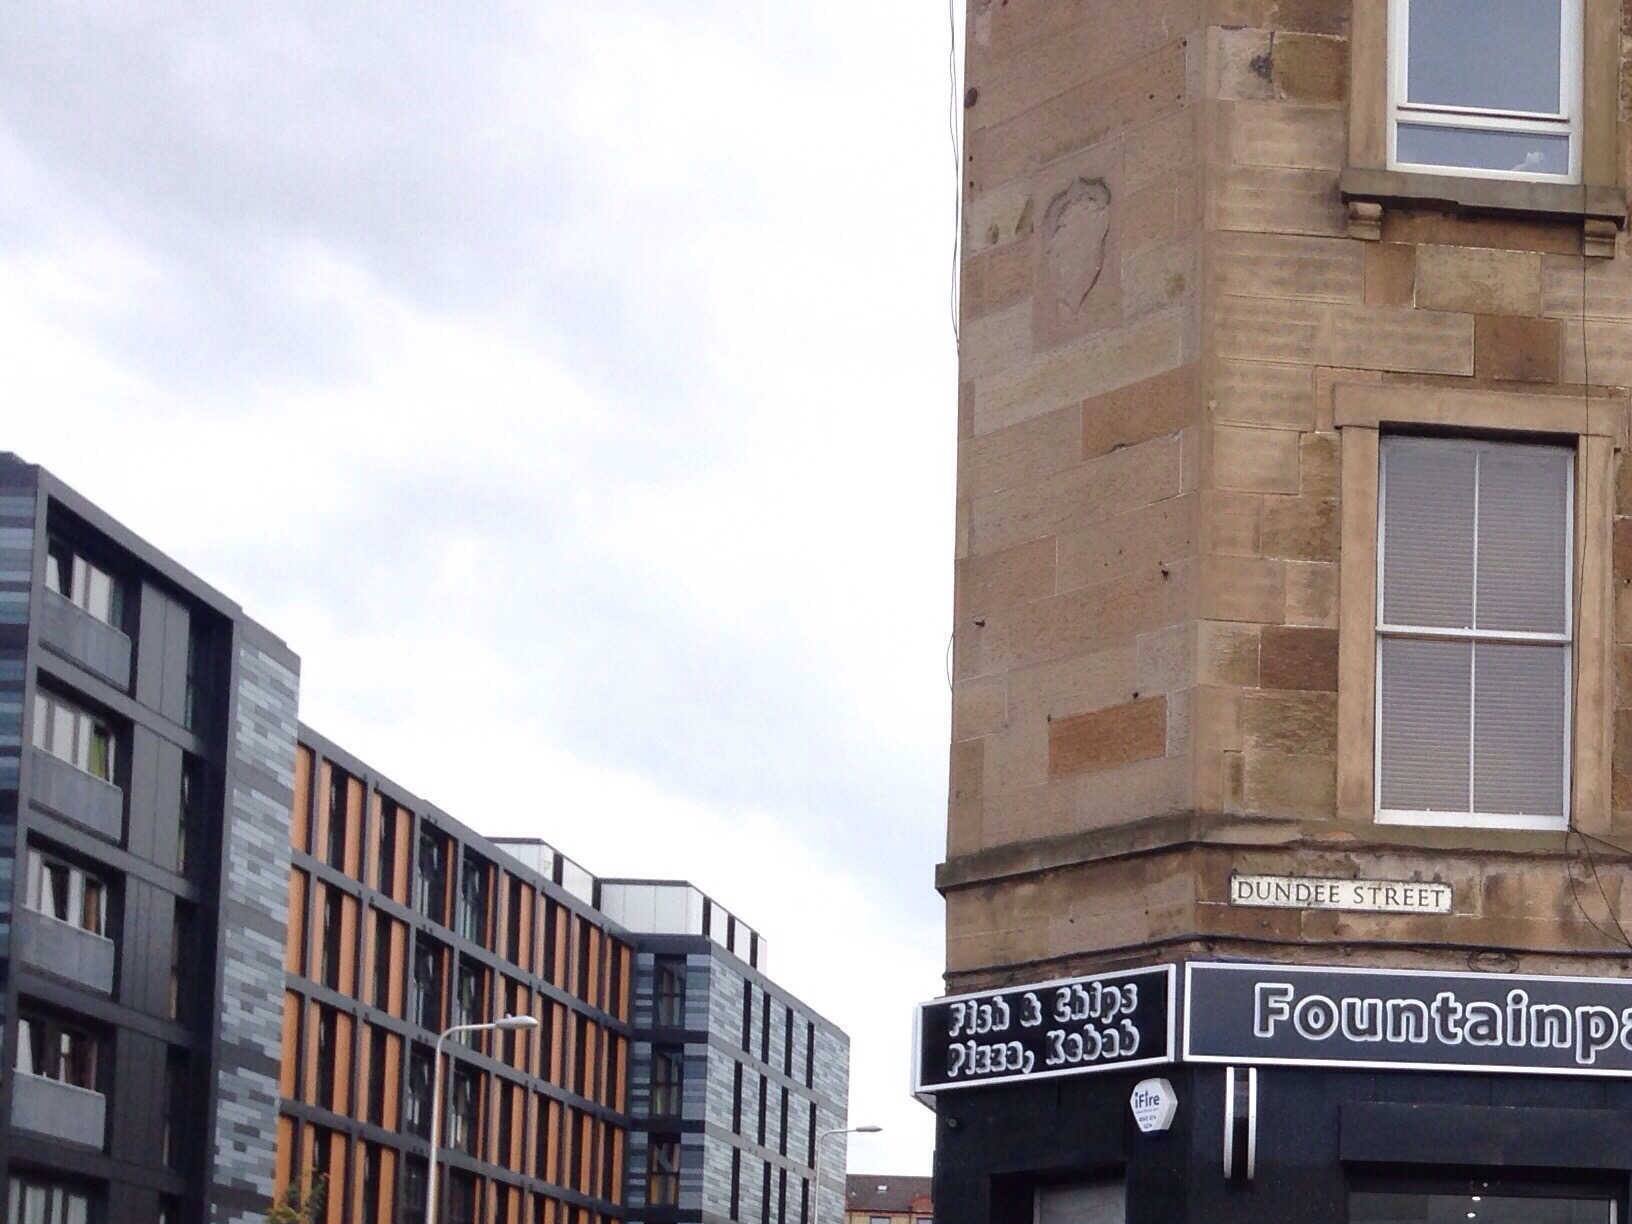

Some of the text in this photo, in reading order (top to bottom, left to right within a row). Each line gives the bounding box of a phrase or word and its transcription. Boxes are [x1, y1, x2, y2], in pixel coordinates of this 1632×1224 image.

[1238, 880, 1445, 908] DUNDEE STREET
[949, 981, 1138, 1037] Fish & Chips
[947, 1018, 1139, 1077] Pizza, Kebab
[1135, 1091, 1160, 1108] iFire
